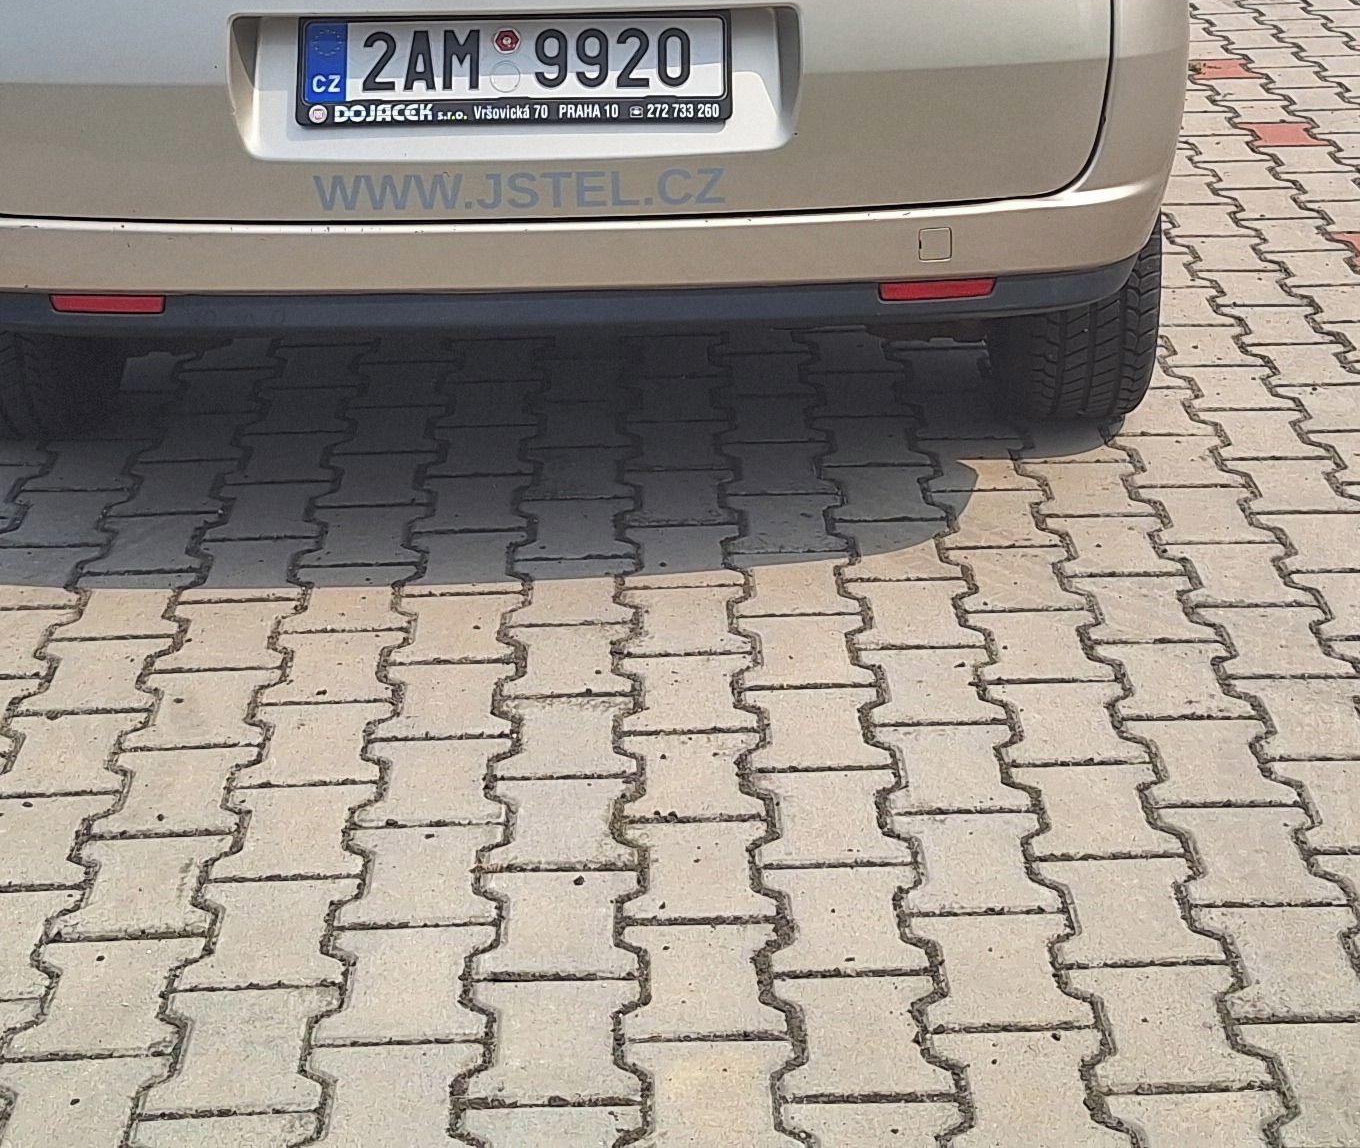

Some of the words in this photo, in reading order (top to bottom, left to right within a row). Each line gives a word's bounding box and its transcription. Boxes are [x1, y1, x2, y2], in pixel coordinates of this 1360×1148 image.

[362, 29, 481, 92] 2AM
[534, 27, 691, 88] 9920
[312, 74, 341, 93] CZ
[334, 104, 433, 123] DOJACEK
[473, 105, 531, 120] Vršovická
[533, 104, 549, 119] 70
[558, 104, 601, 119] PRAHA
[604, 104, 620, 118] 10
[646, 103, 669, 118] 272
[671, 103, 694, 118] 733
[697, 103, 720, 118] 260
[312, 167, 727, 212] WWW.JSTEL.CZ
